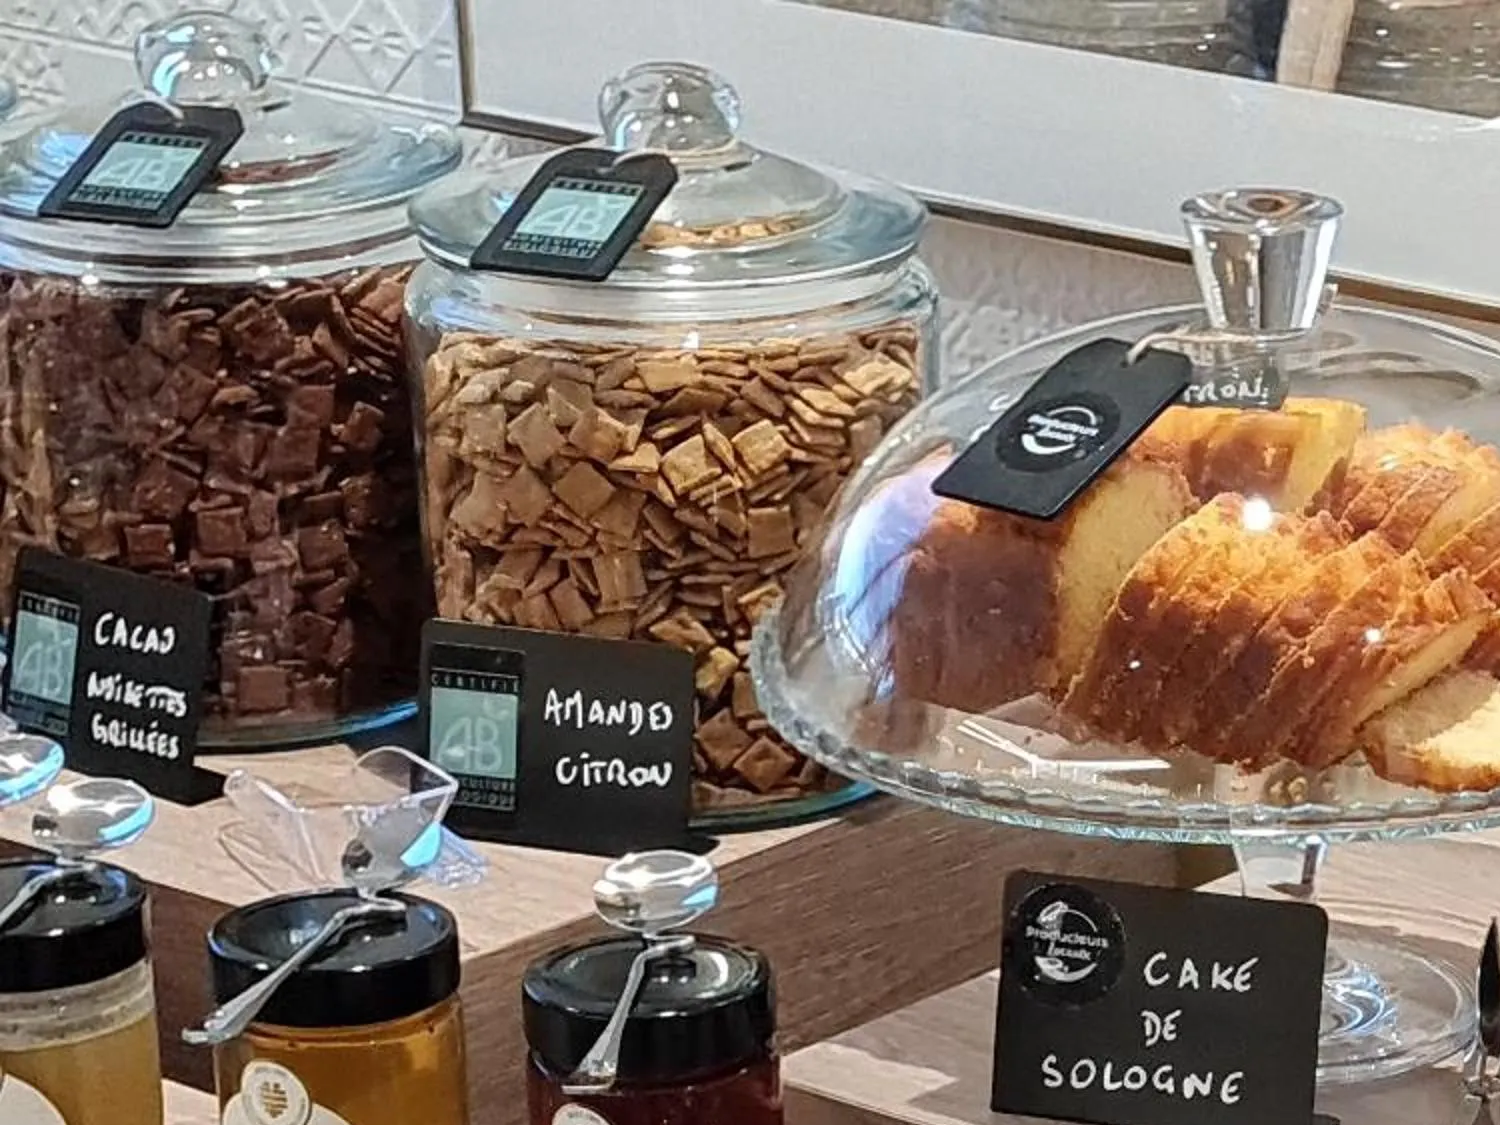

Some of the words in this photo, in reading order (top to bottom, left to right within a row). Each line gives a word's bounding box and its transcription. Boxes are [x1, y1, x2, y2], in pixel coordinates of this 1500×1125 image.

[94, 612, 176, 655] CACAO
[86, 671, 188, 718] NOISETTES
[544, 687, 674, 736] AMANDES
[91, 712, 180, 760] GRILLÉES
[556, 752, 673, 787] CITRON
[1026, 925, 1109, 949] Producteurs
[1143, 951, 1260, 992] CAKE
[1141, 1009, 1183, 1047] DE
[1041, 1055, 1245, 1104] SOLOGNE
